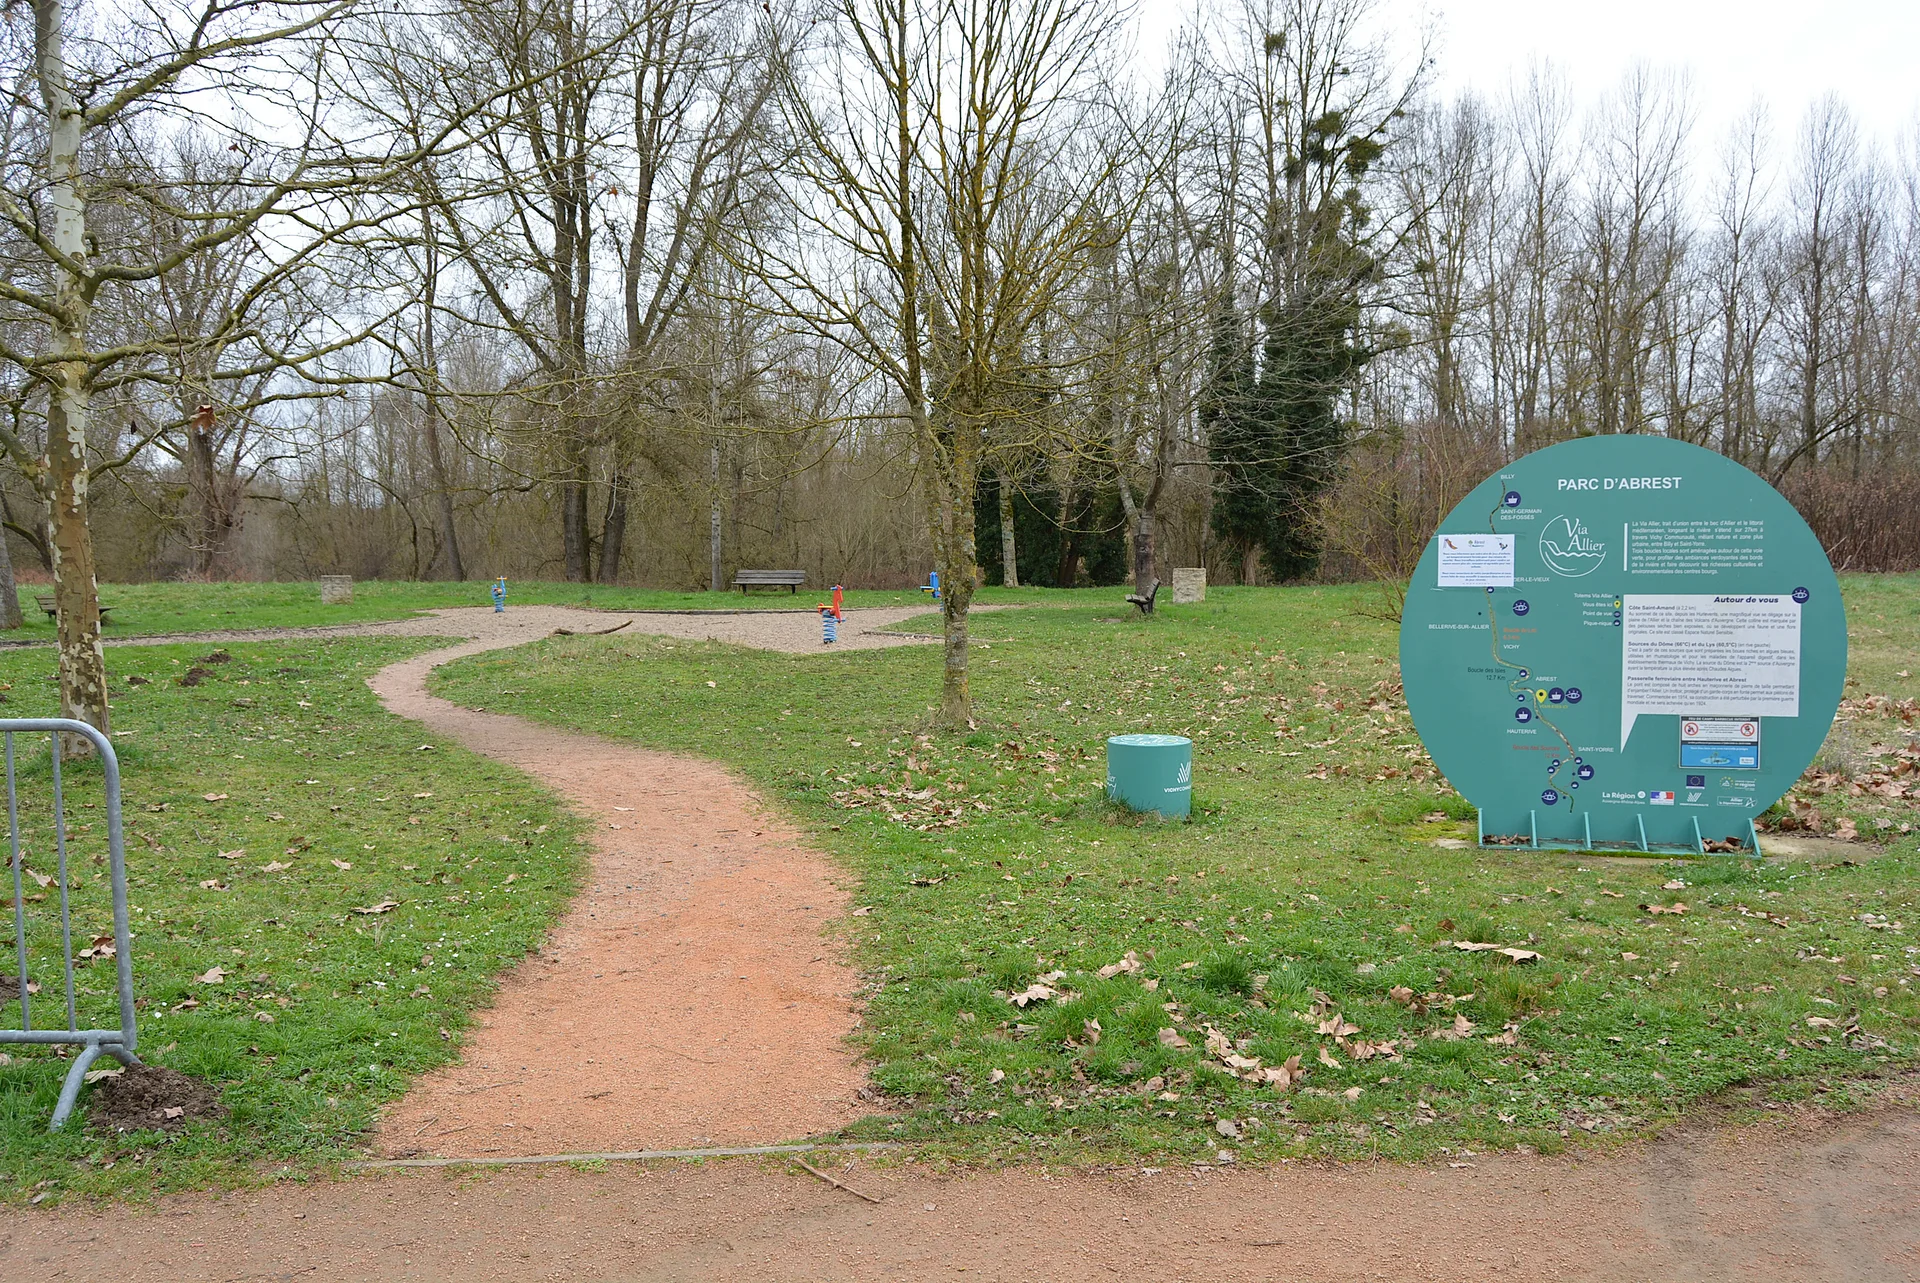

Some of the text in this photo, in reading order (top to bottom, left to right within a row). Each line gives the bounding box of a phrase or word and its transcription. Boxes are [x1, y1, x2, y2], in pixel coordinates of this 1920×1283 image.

[1558, 477, 1682, 490] PARC D'ABREST
[1563, 518, 1588, 537] Via
[1568, 534, 1605, 551] Allier
